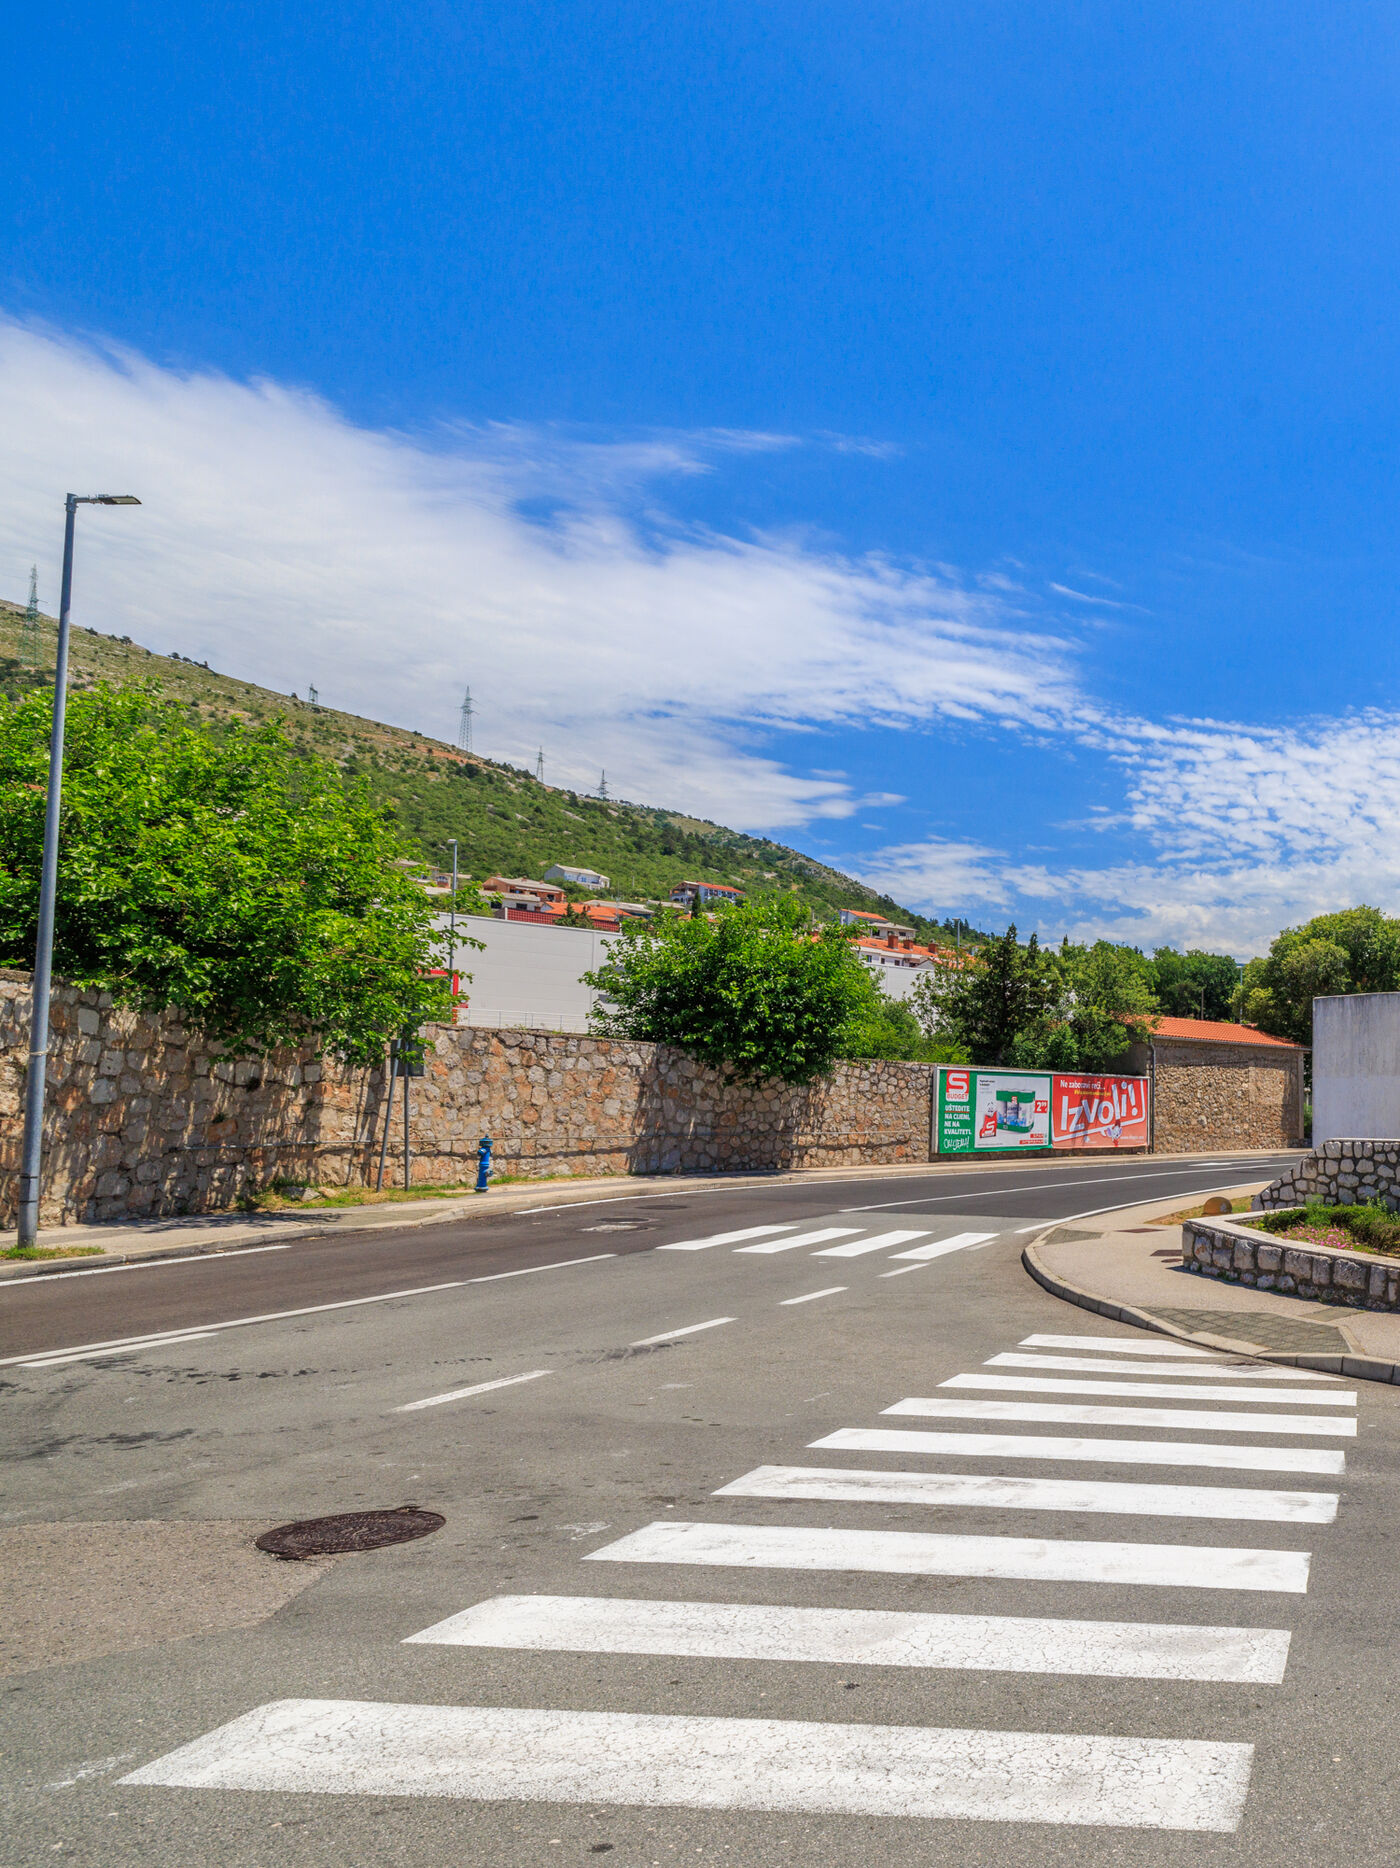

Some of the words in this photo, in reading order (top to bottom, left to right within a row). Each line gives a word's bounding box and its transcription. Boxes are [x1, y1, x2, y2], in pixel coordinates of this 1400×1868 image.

[948, 1072, 968, 1094] S
[1060, 1080, 1068, 1088] Ne
[1069, 1080, 1090, 1089] zaboravi
[944, 1103, 970, 1112] UŠTEDITE
